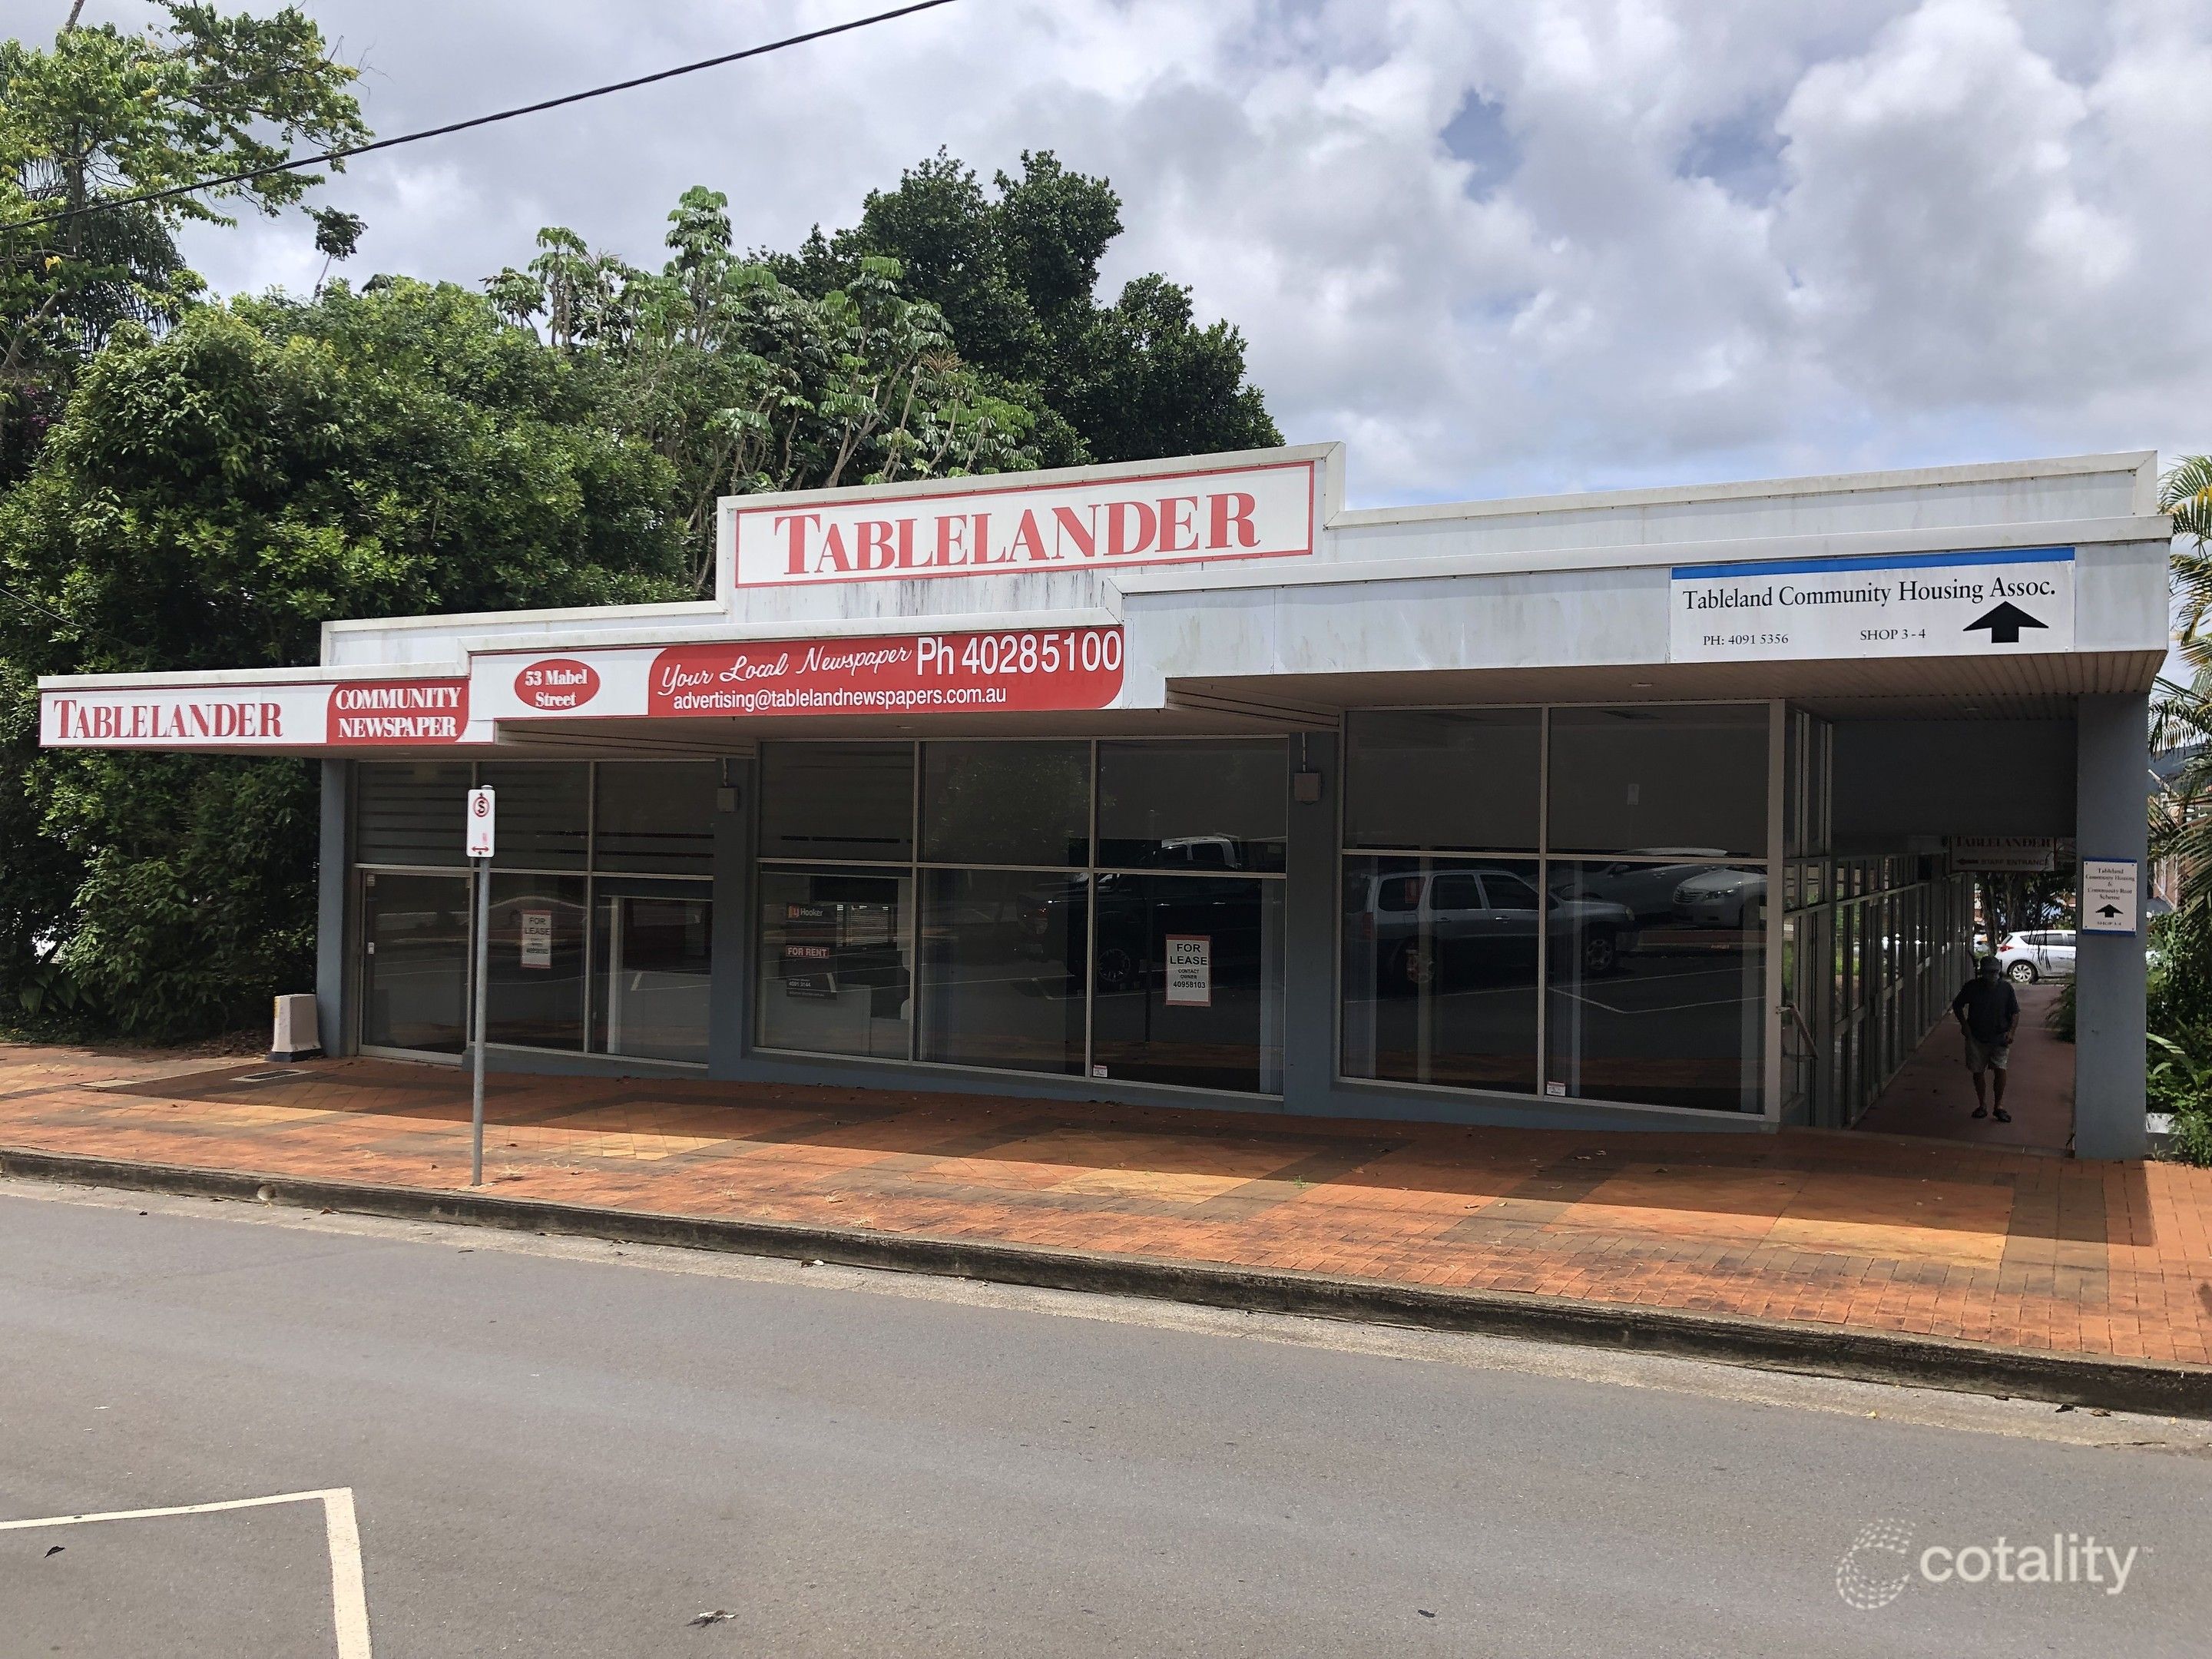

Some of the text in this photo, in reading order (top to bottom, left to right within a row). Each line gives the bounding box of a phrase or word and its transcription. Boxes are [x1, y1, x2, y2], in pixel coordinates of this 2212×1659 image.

[774, 492, 1262, 575] TABLELANDER
[1683, 576, 2056, 609] Tableland Community Housing Assoc.
[1703, 633, 1789, 646] PH: 4091 5356
[1859, 629, 1898, 641] SHOP
[657, 631, 1122, 696] Your Local Newspaper Ph 40285100
[525, 668, 588, 686] 53 Mabel
[336, 687, 462, 710] COMMUNITY
[535, 691, 577, 707] Street
[674, 686, 1007, 711] advertising@tablelandnewspapers.com.au
[54, 700, 283, 739] TABLELANDER
[338, 717, 457, 739] NEWSPAPER
[800, 908, 823, 916] Hooker
[525, 927, 551, 935] LEASE
[787, 947, 827, 956] FOR RENT
[1177, 944, 1200, 952] FOR
[1170, 955, 1207, 965] LEASE
